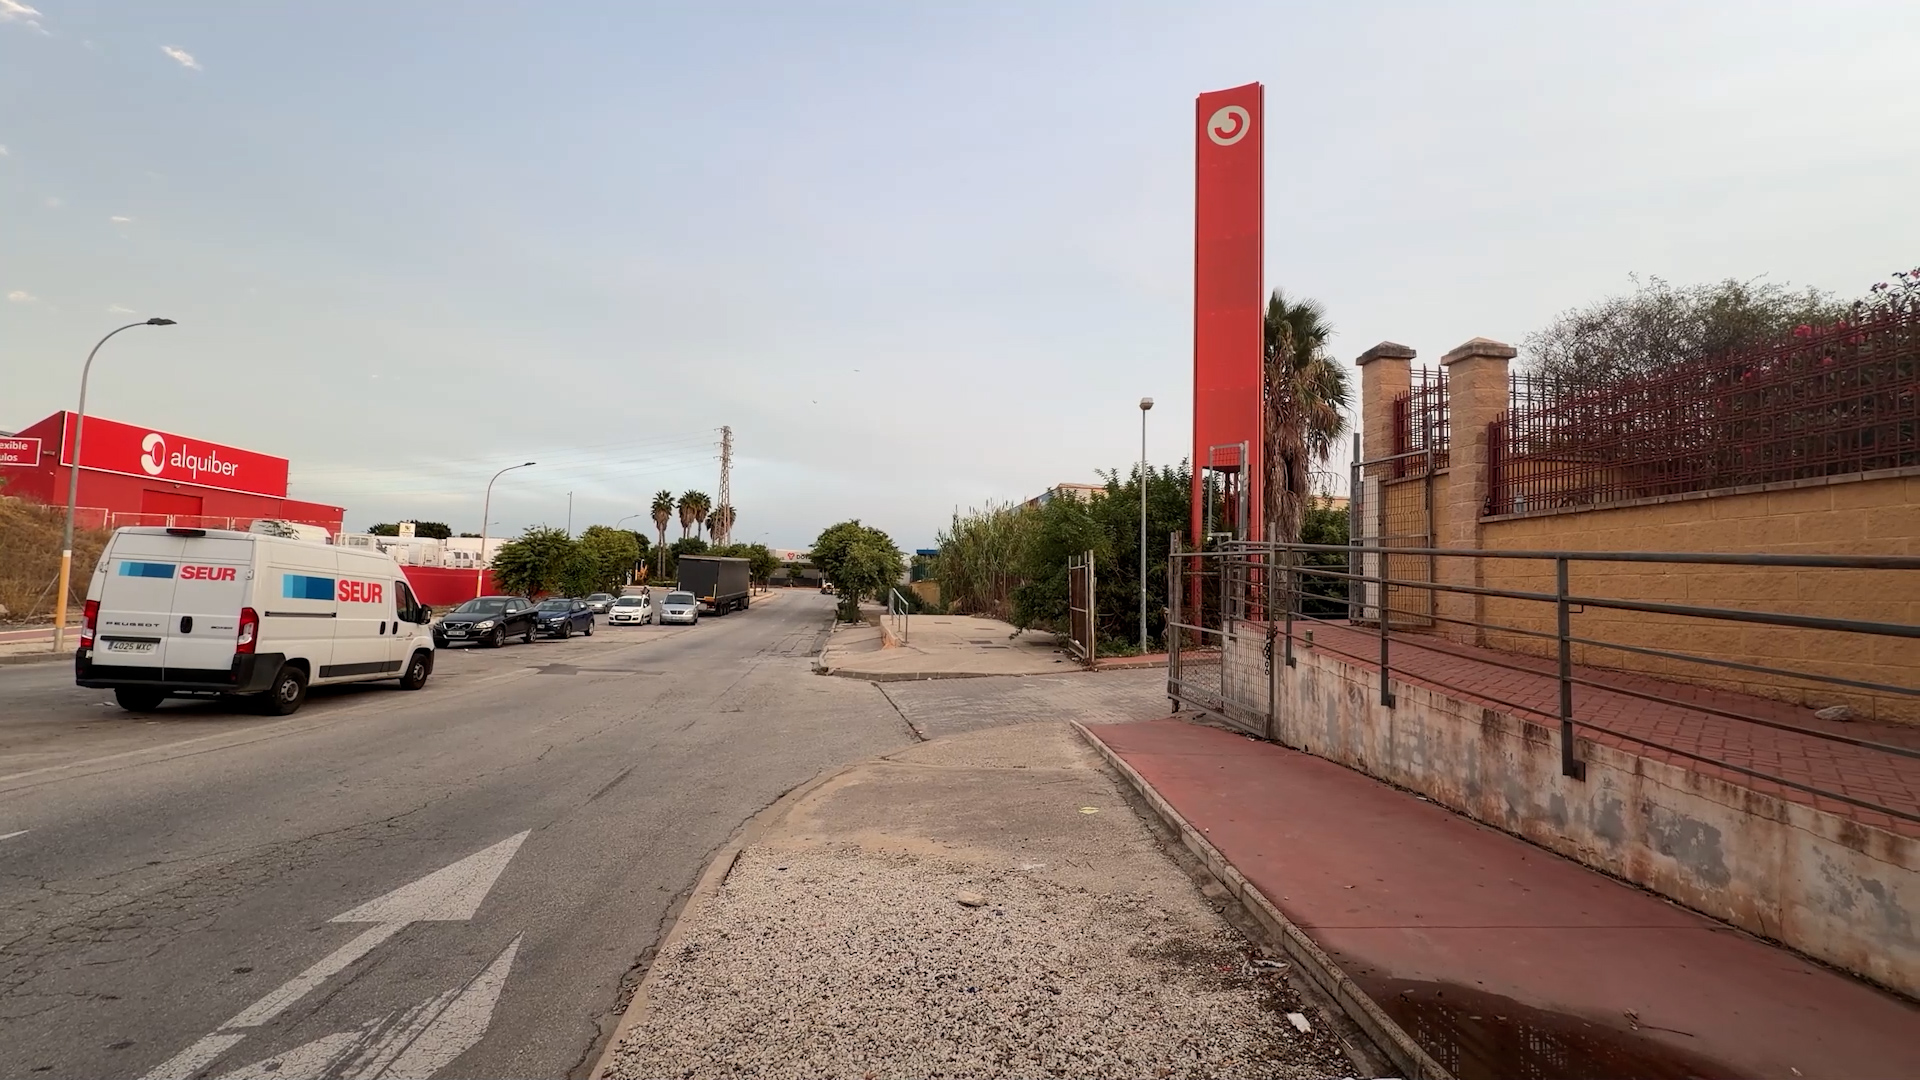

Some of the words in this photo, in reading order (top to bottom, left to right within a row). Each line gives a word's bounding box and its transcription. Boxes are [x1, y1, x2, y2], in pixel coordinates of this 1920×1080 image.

[170, 444, 239, 480] alquiber
[180, 565, 237, 581] SEUR
[338, 579, 383, 604] SEUR
[113, 642, 134, 650] 4025
